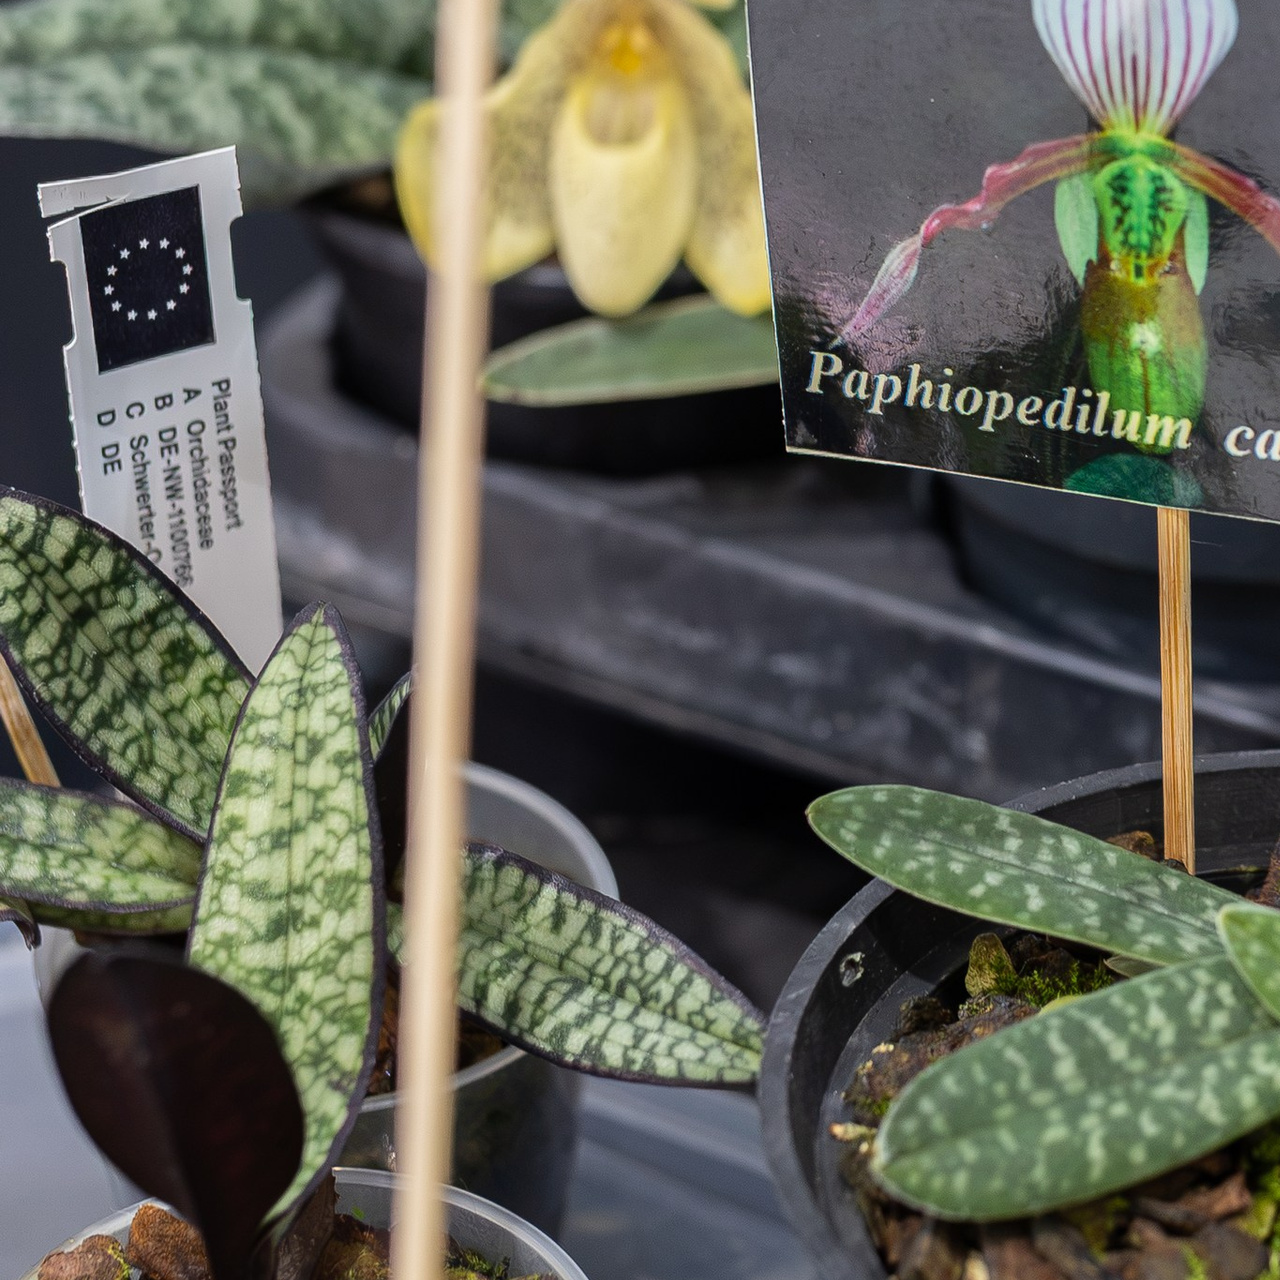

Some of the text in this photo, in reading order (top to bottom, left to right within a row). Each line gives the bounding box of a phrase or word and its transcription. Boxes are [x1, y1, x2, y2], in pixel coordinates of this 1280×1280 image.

[125, 401, 145, 420] C
[154, 392, 174, 411] B
[805, 349, 1193, 450] Paphiopedilum
[97, 408, 122, 476] D DE
[182, 387, 214, 550] A Orchidaceae
[210, 376, 244, 532] Plant Passport
